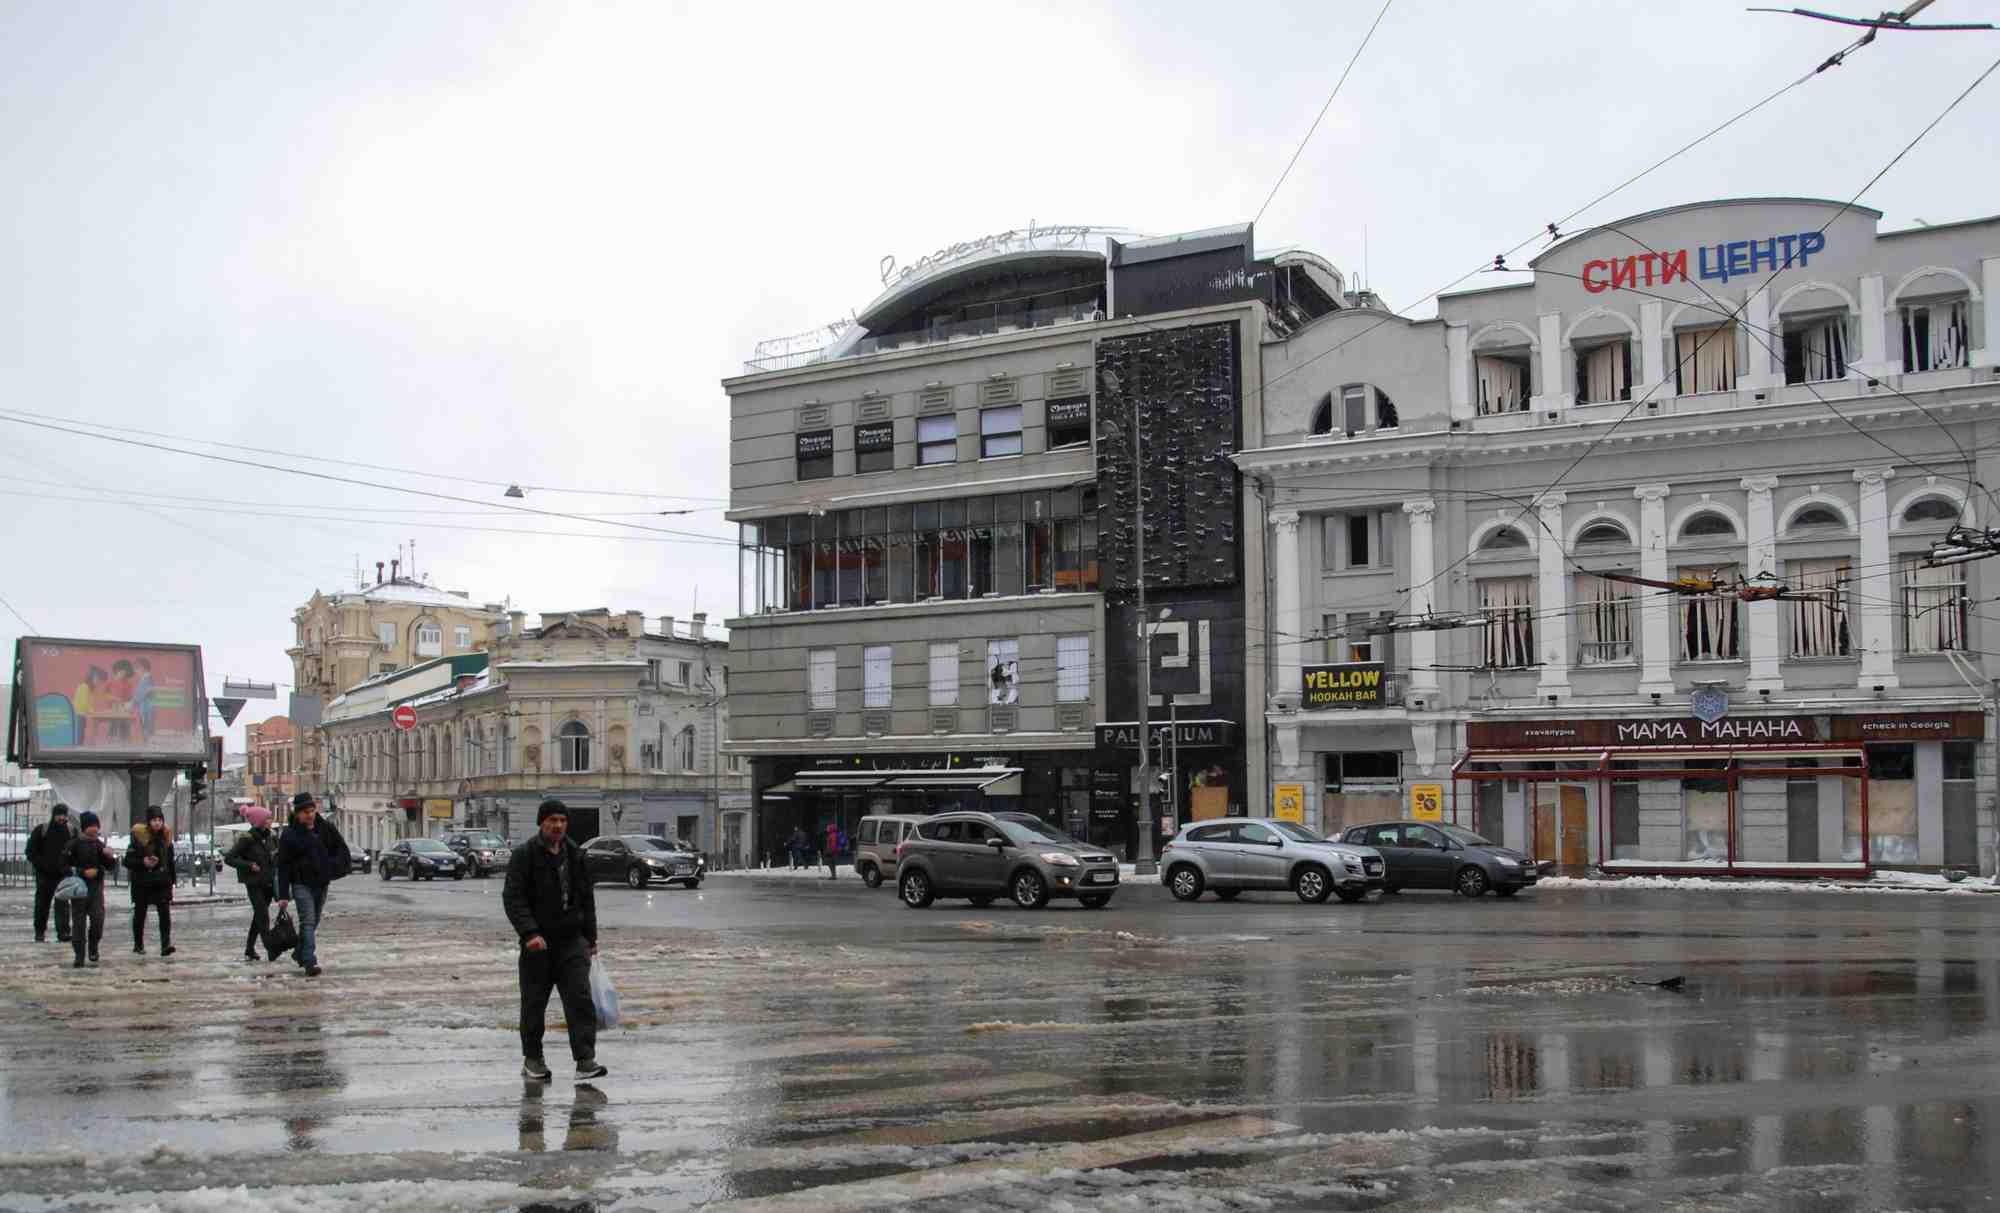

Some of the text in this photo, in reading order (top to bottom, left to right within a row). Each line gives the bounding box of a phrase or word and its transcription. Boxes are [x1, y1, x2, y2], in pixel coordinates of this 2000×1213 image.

[1583, 231, 1826, 294] СИТИ ЦЕНТР
[1305, 670, 1380, 689] YELLOW
[1310, 690, 1377, 703] HOOKAH BAR
[1618, 719, 1803, 741] МАМА МАНАНА
[1910, 721, 1950, 730] Georgia
